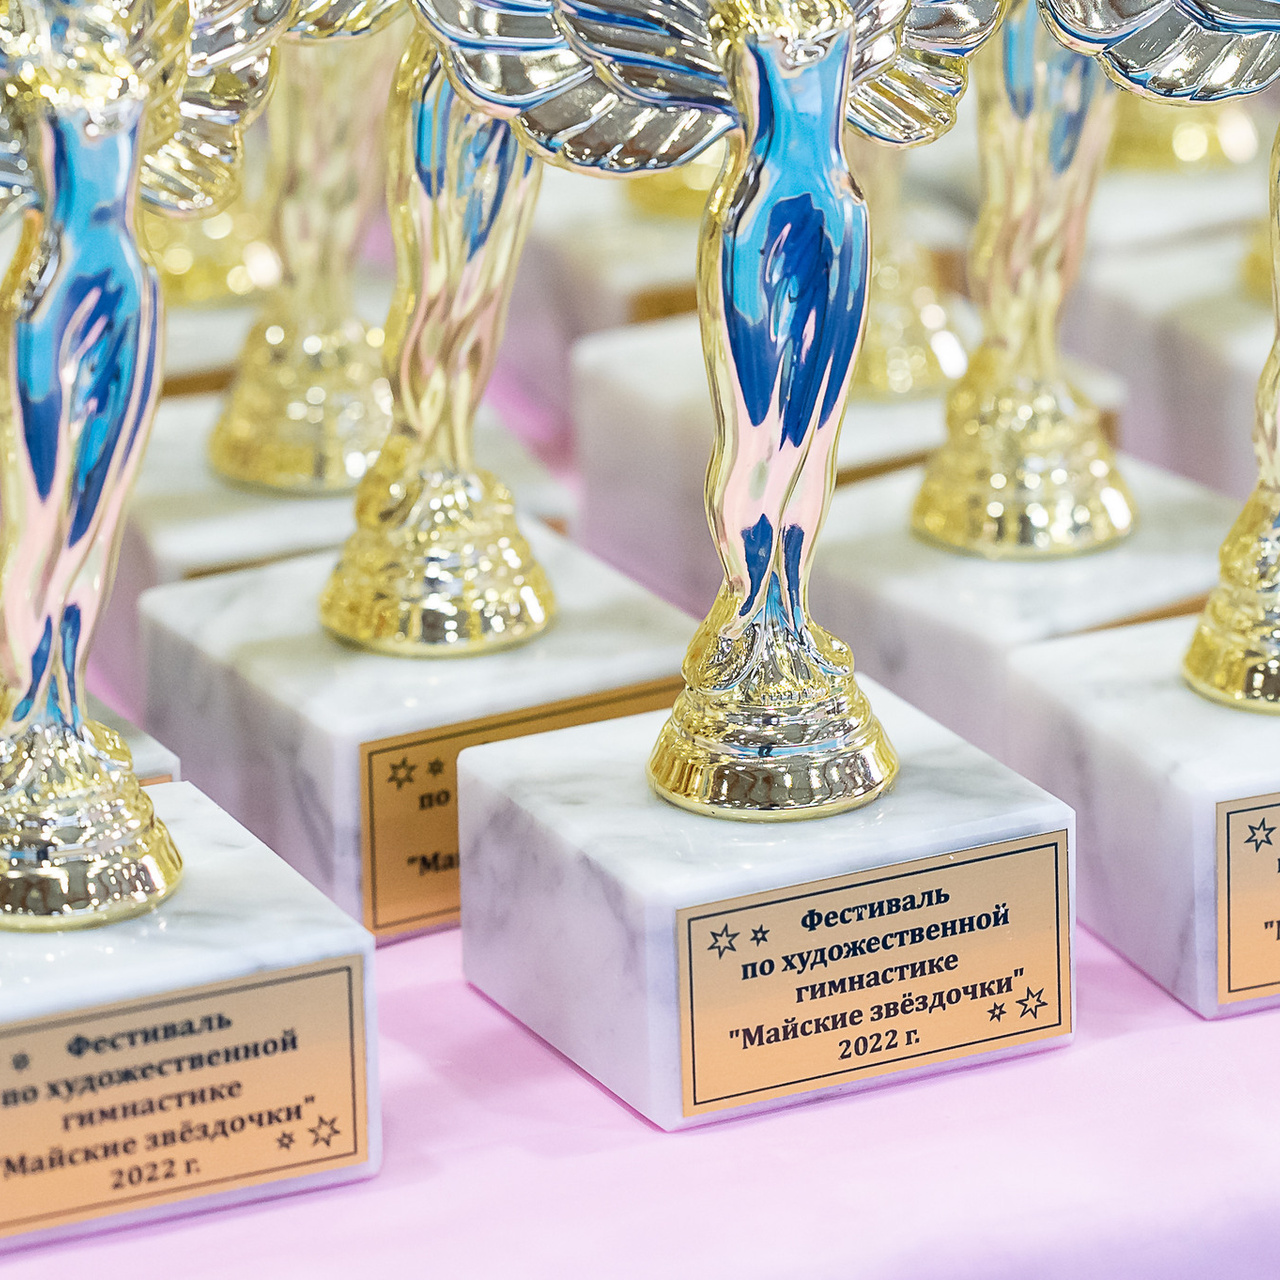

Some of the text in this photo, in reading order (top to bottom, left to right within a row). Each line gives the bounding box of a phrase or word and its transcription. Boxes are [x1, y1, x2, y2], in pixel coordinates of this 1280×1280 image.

[418, 789, 451, 810] по
[801, 888, 950, 933] Фестиваль
[742, 903, 1010, 980] по художественной
[795, 953, 959, 1004] гимнастике
[729, 968, 1025, 1050] "Майские звёздочки"
[67, 1013, 233, 1058] Фестиваль
[837, 1028, 921, 1060] 2022 г.
[2, 1027, 299, 1108] по художественной
[62, 1080, 243, 1132] гимнастике
[111, 1159, 177, 1190] 2022
